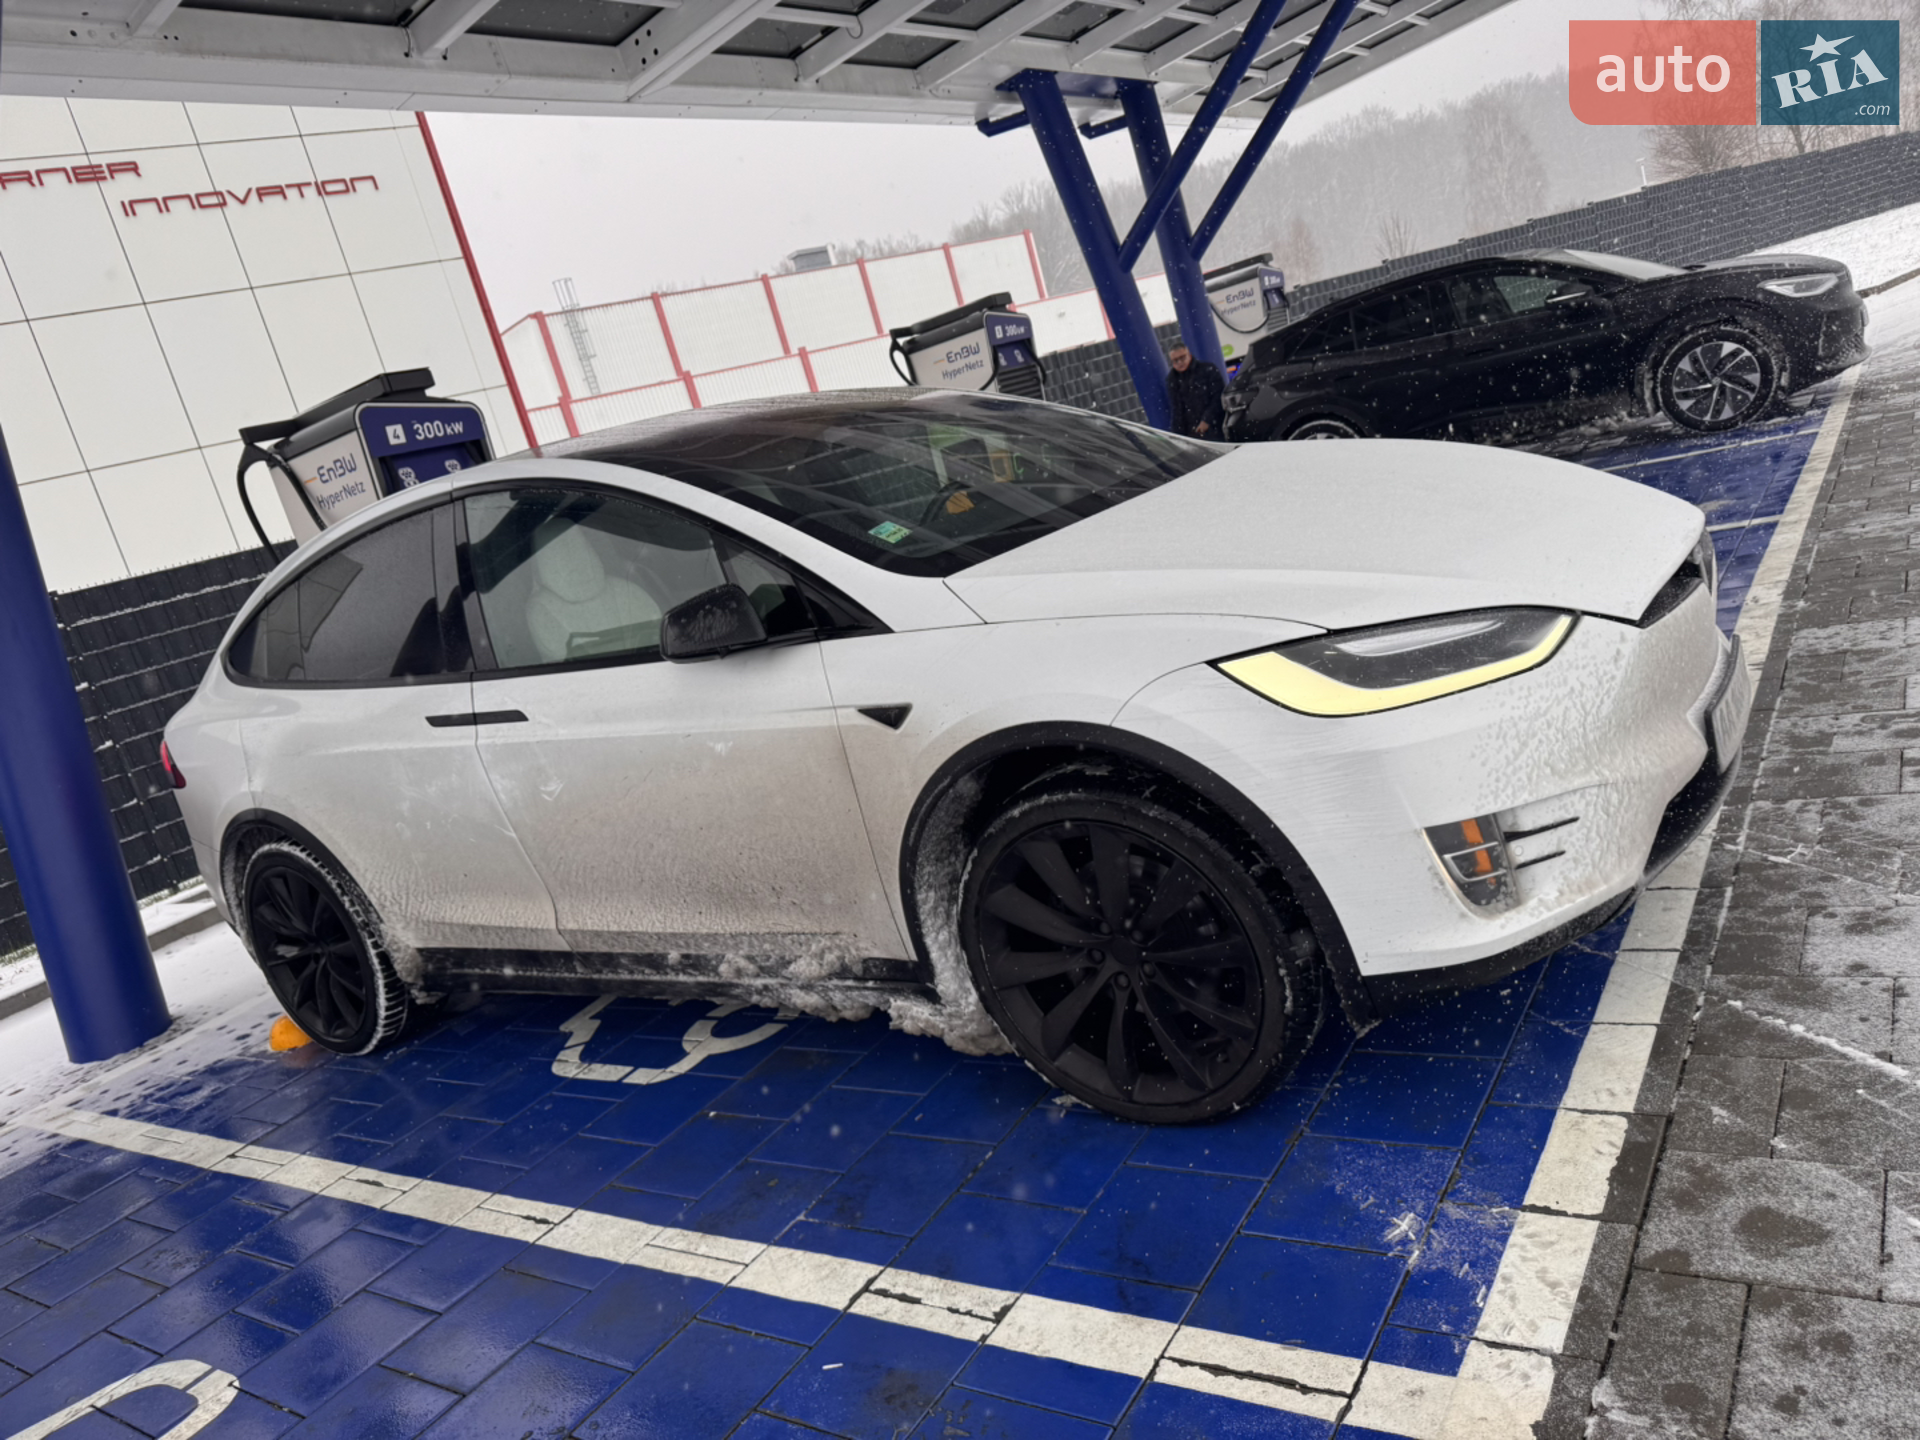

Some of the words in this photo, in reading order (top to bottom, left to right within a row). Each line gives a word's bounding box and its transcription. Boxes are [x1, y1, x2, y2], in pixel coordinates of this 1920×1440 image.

[120, 175, 379, 217] INNOVATION
[1225, 287, 1255, 304] EnBW
[945, 342, 981, 364] EnBW
[941, 359, 985, 380] HyperNetz
[392, 428, 401, 441] 4
[413, 420, 444, 441] 300
[444, 421, 464, 436] kW
[316, 453, 358, 484] EnBW
[315, 481, 367, 511] HyperNetz
